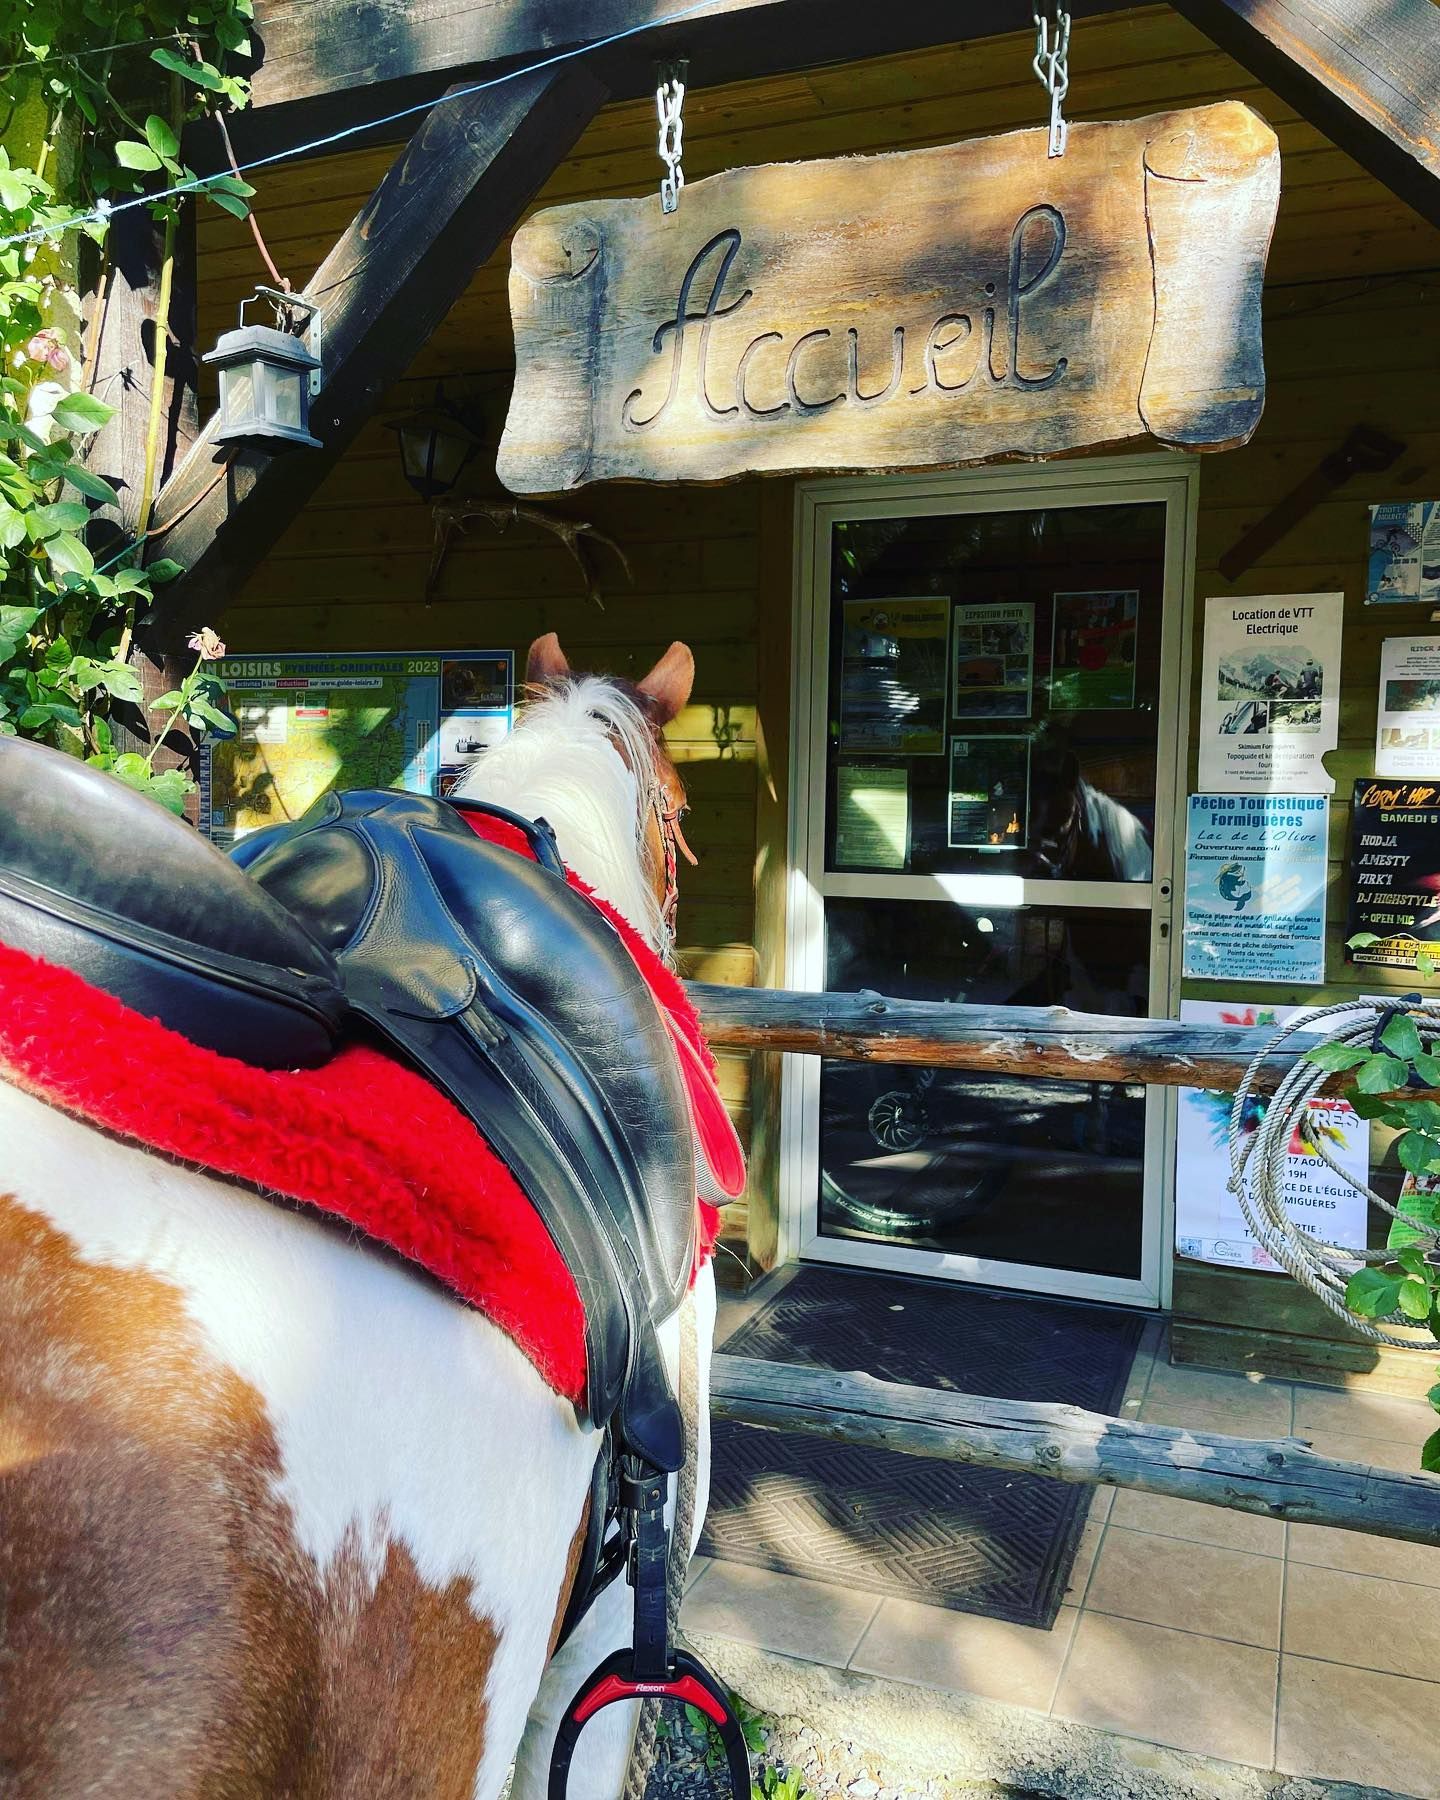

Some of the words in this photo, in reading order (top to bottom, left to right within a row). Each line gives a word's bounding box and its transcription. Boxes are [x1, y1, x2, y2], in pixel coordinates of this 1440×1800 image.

[621, 203, 1068, 434] Accueil
[1231, 609, 1276, 621] Location
[1278, 608, 1291, 619] de
[1292, 607, 1314, 618] VTT
[1246, 622, 1299, 636] Electrique
[221, 662, 281, 677] LOISIRS
[407, 660, 439, 672] 2023
[1227, 752, 1257, 761] Topoguide
[1258, 752, 1264, 760] et
[1191, 796, 1236, 810] Pêche
[1239, 796, 1325, 812] Touristique
[1211, 813, 1303, 828] Formiguères
[1380, 813, 1427, 824] SAMEDI
[1197, 830, 1223, 841] Lac
[1231, 831, 1249, 841] de
[1194, 843, 1244, 851] Ouverture
[1188, 853, 1229, 862] Fermeture
[1230, 853, 1266, 862] dimanche
[1356, 892, 1373, 904] DJ
[1188, 911, 1213, 920] Espace
[1214, 913, 1255, 922] pique-nique
[1370, 913, 1395, 924] OPEN
[1396, 914, 1416, 926] MIC
[1288, 924, 1308, 933] place
[1210, 930, 1242, 938] arc-en-ciel
[1278, 932, 1290, 940] des
[1291, 933, 1321, 941] fontaines
[1211, 940, 1232, 948] Permis
[1241, 941, 1260, 950] pêche
[1261, 942, 1295, 950] obligatoire
[1286, 1157, 1298, 1166] 17
[1288, 1170, 1307, 1181] 19H
[1299, 1184, 1313, 1196] DE
[1315, 1185, 1359, 1201] L'ÉGLISE
